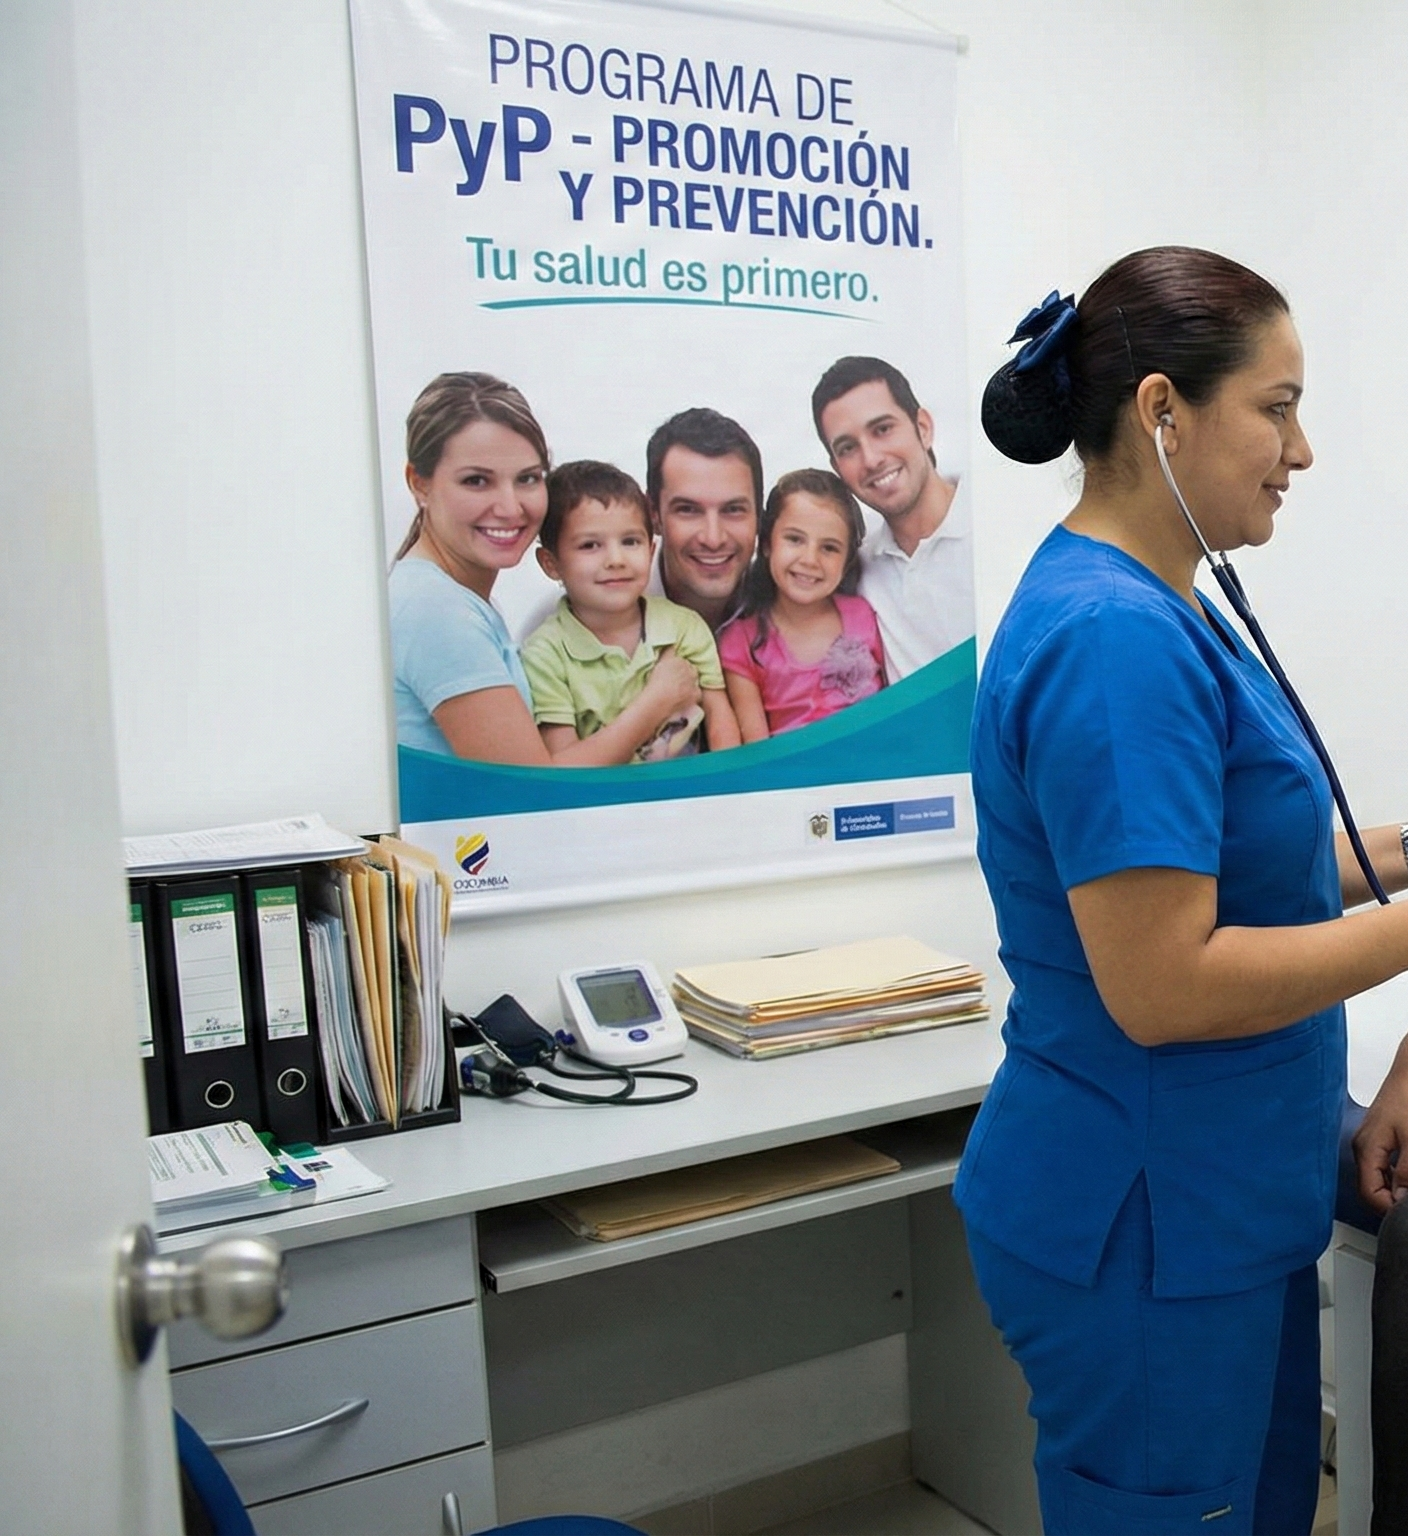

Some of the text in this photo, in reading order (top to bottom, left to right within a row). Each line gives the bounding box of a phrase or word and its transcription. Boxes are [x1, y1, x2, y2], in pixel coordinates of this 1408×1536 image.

[489, 33, 854, 126] PROGRAMA DE
[393, 93, 552, 196] PyP
[612, 114, 910, 191] PROMOCIÓN
[558, 170, 934, 249] Y PREVENCIÓN.
[465, 236, 878, 303] Tu salud es primero.
